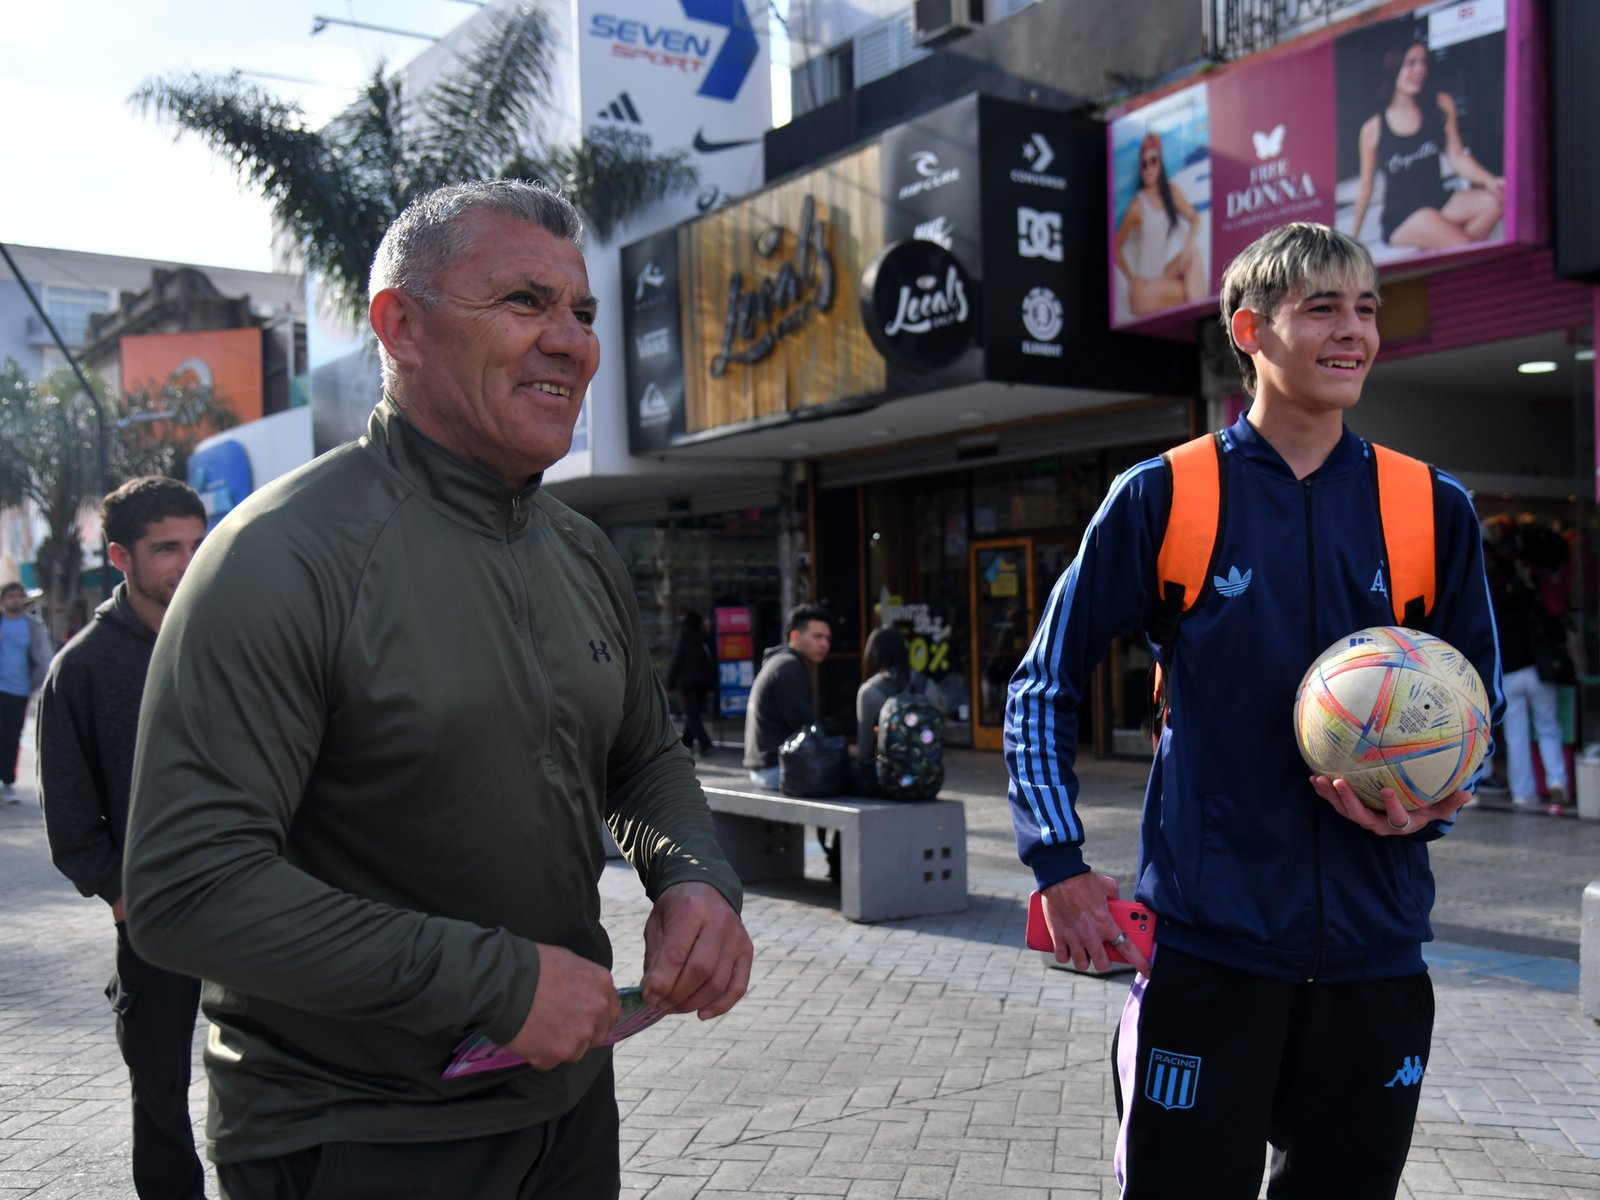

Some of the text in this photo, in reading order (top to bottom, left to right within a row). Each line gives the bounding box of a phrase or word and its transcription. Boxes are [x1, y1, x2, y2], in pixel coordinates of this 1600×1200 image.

[590, 14, 711, 57] SEVEN
[611, 43, 706, 74] SPORT
[1226, 172, 1315, 219] DONNA
[884, 265, 968, 336] Locals
[908, 637, 949, 672] 0%
[1426, 690, 1444, 710] adidas
[1155, 1053, 1196, 1069] RACING
